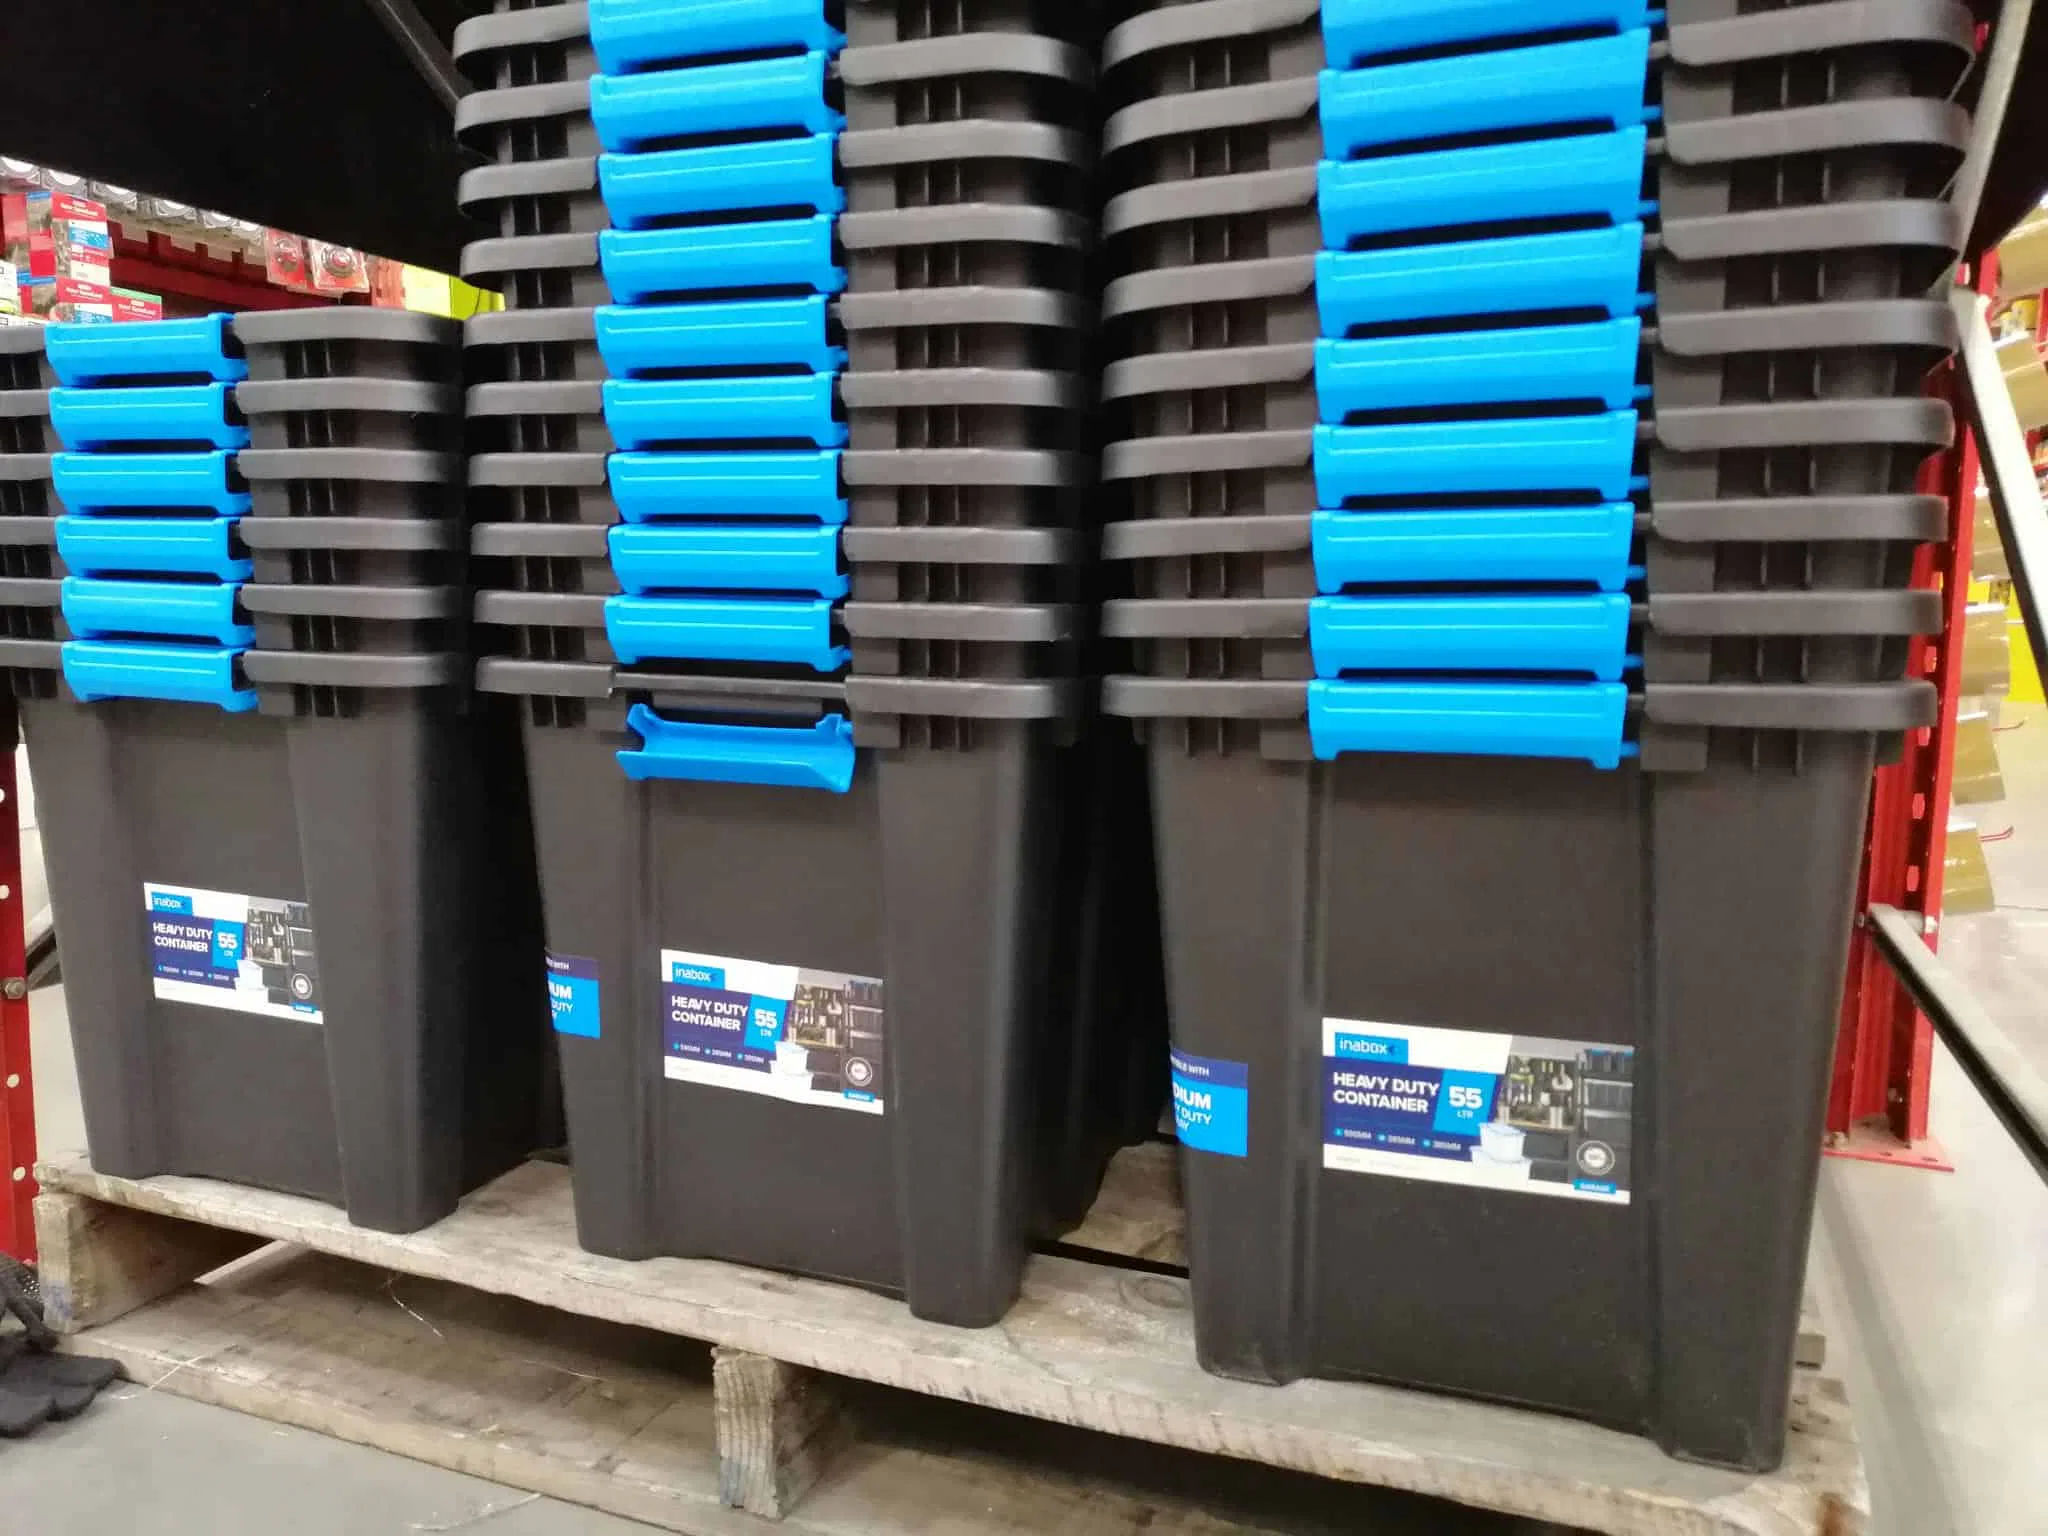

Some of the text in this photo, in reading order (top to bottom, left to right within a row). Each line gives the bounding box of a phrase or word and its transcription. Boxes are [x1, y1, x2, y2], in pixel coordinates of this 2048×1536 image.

[152, 921, 213, 940] HEAVY DUTY
[217, 931, 239, 950] 55
[154, 935, 209, 953] CONTAINER
[675, 967, 712, 983] inabox
[671, 994, 749, 1017] HEAVY DUTY
[671, 1010, 742, 1032] CONTAINER
[754, 1008, 778, 1029] 55
[1339, 1037, 1389, 1056] inabox
[1333, 1071, 1440, 1097] HEAVY DUTY
[1332, 1089, 1429, 1113] CONTAINER
[1448, 1085, 1483, 1109] 55
[1456, 1109, 1474, 1121] LTR
